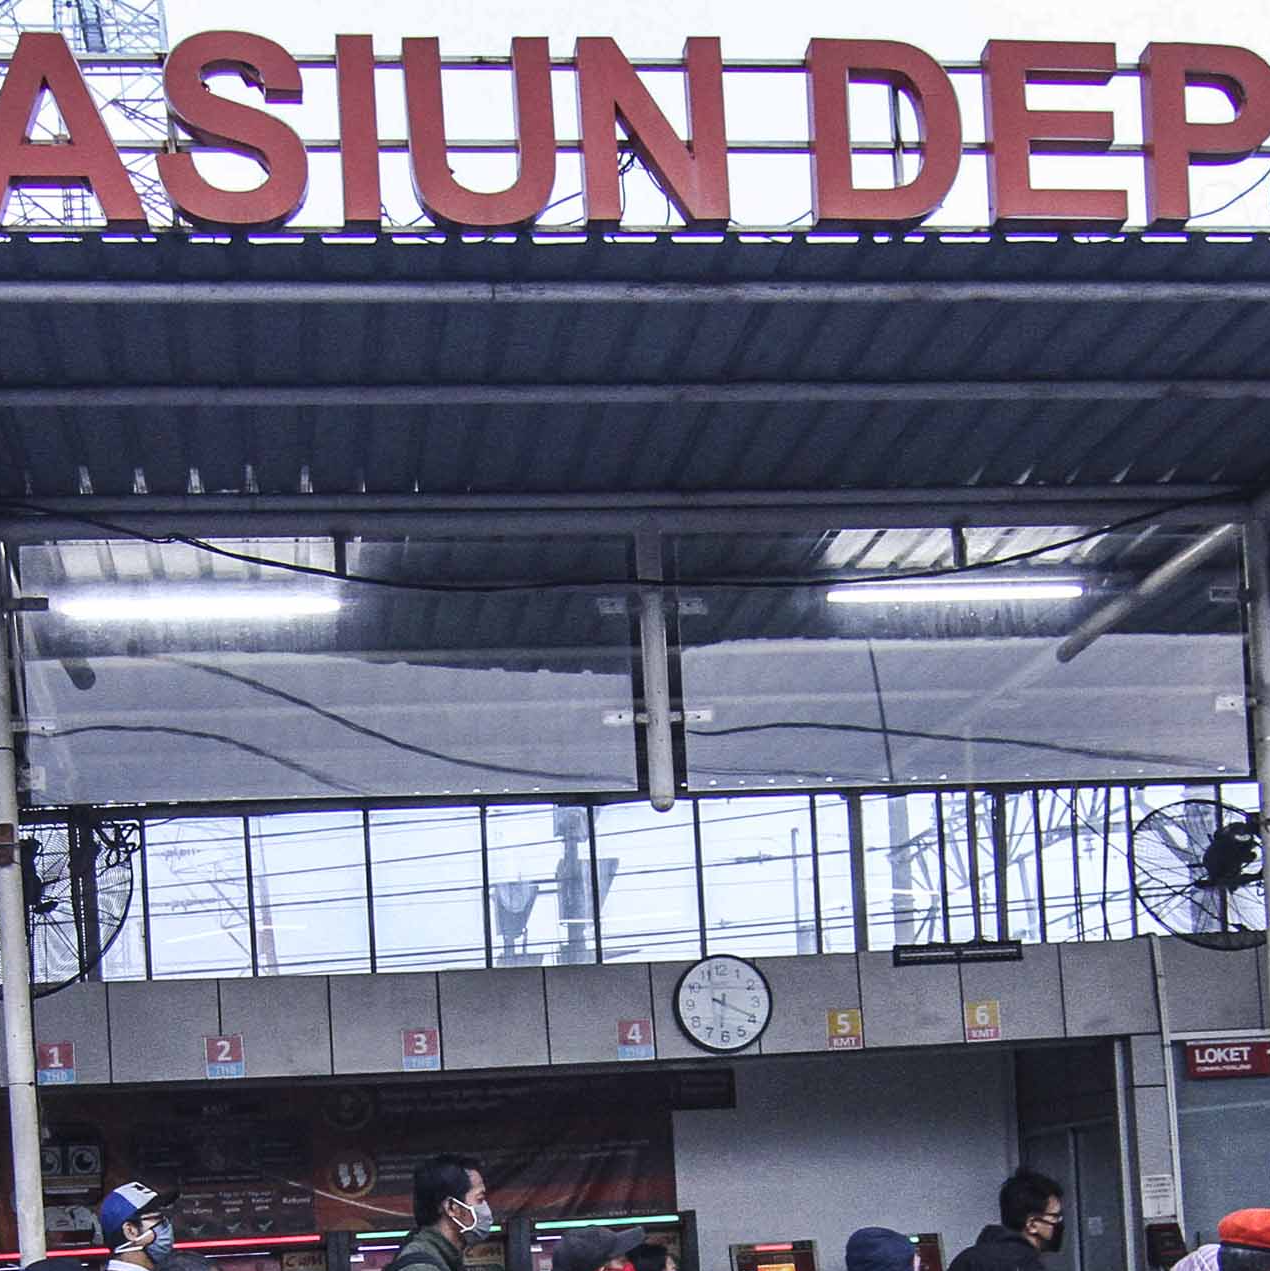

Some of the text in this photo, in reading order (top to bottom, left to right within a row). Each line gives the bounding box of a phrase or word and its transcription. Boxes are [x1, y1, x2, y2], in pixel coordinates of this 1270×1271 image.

[837, 1013, 851, 1034] 5
[976, 1005, 990, 1025] 6
[413, 1033, 427, 1054] 3
[627, 1023, 643, 1044] 4
[833, 1037, 857, 1048] KMT
[971, 1028, 995, 1039] KMT
[48, 1046, 64, 1068] 1
[216, 1040, 232, 1061] 2
[1194, 1046, 1252, 1064] LOKET
